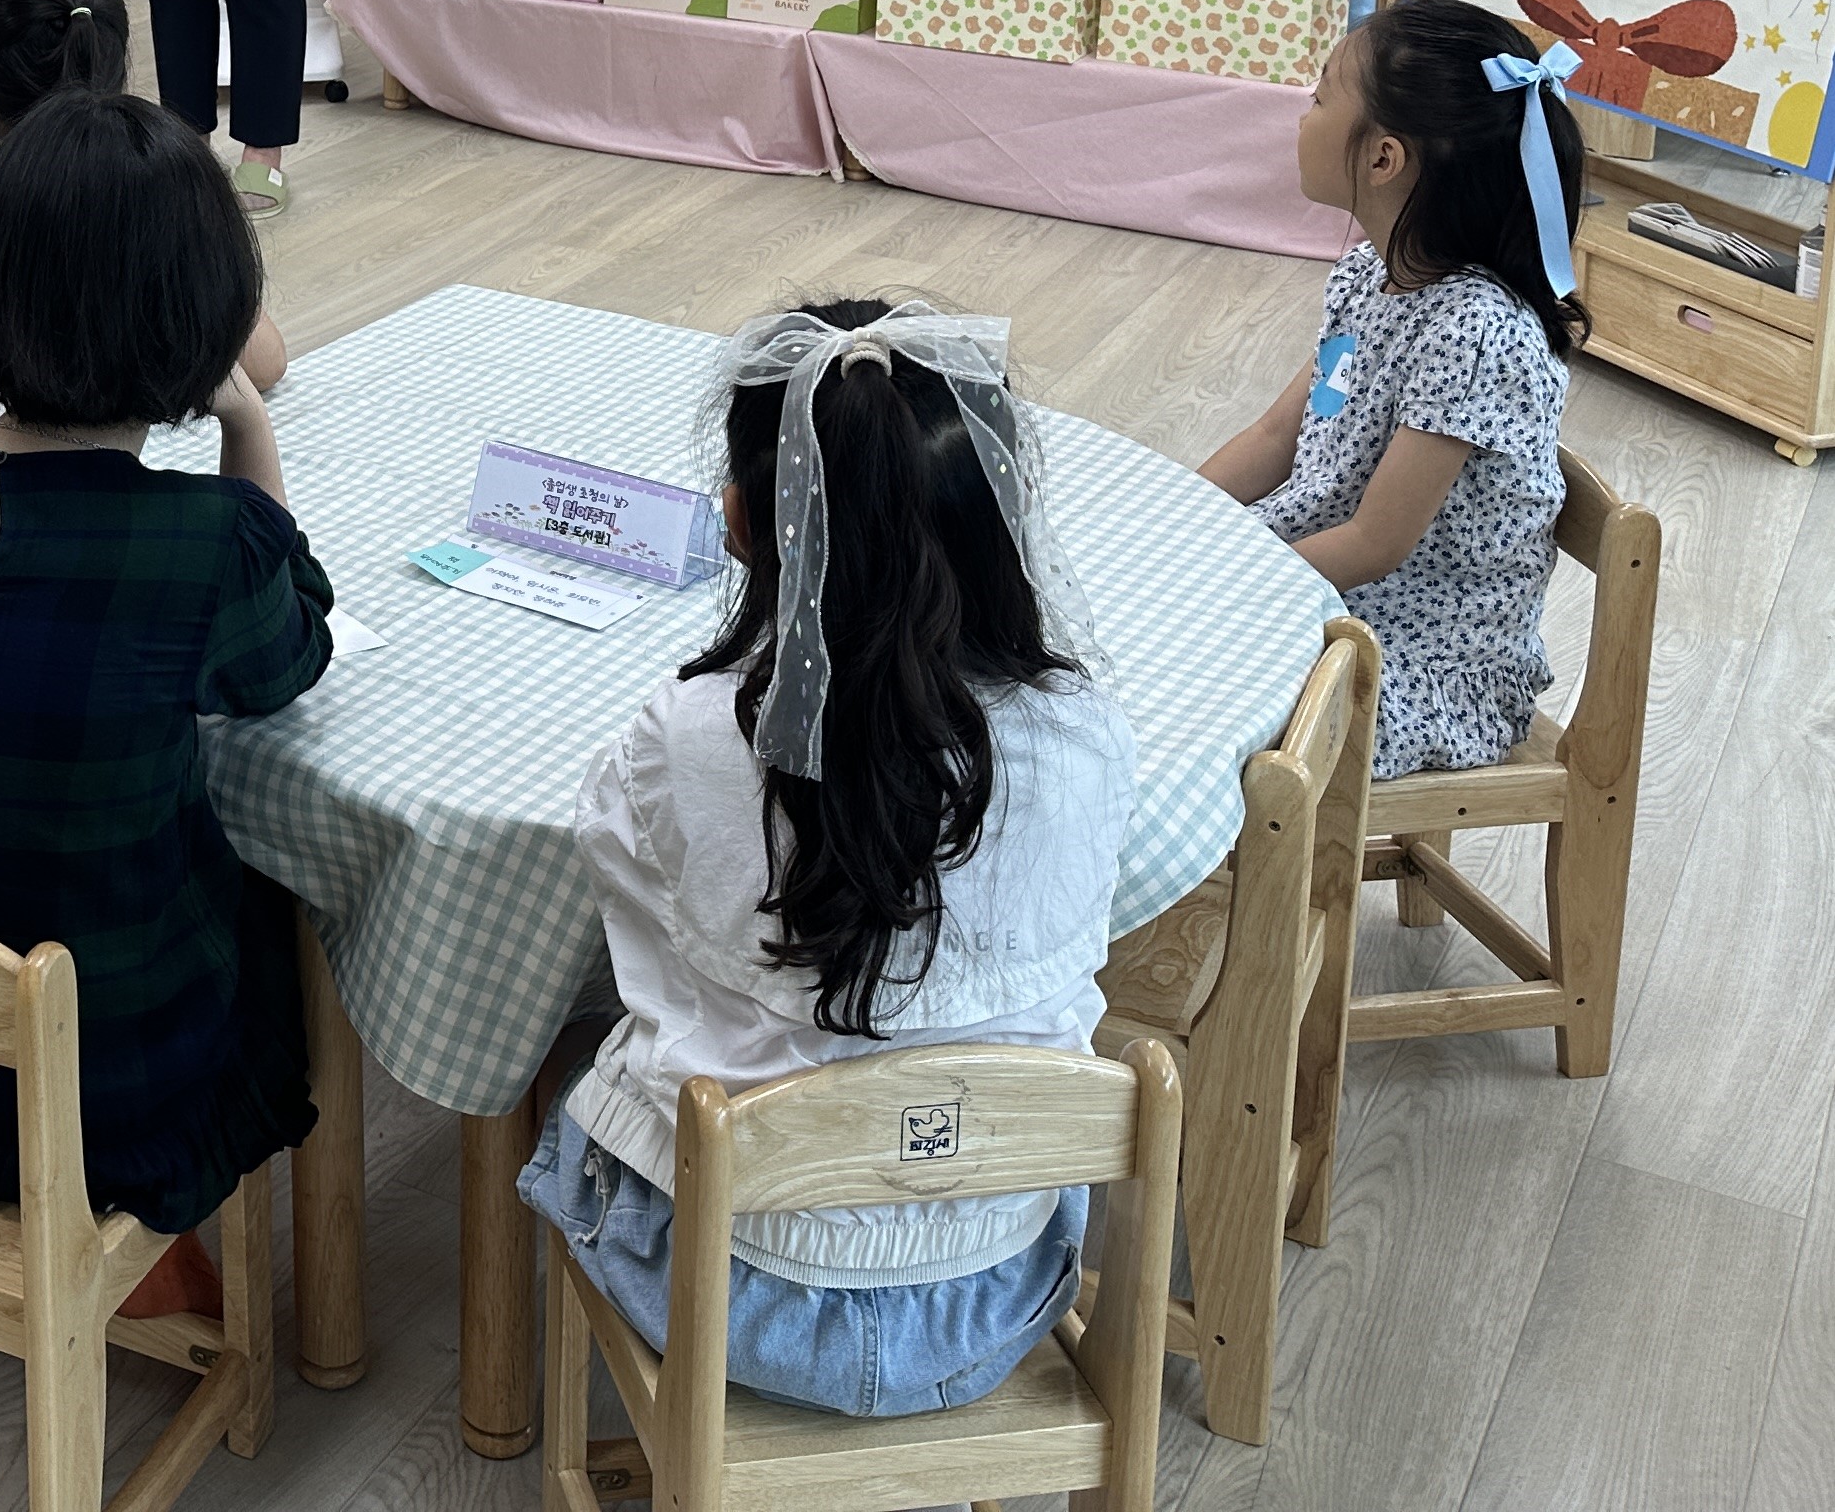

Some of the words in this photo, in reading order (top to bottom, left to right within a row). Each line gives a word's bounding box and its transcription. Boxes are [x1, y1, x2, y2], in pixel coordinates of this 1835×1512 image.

[774, 1, 810, 11] BAKERY
[542, 494, 560, 515] 책
[562, 500, 616, 528] 읽어주기
